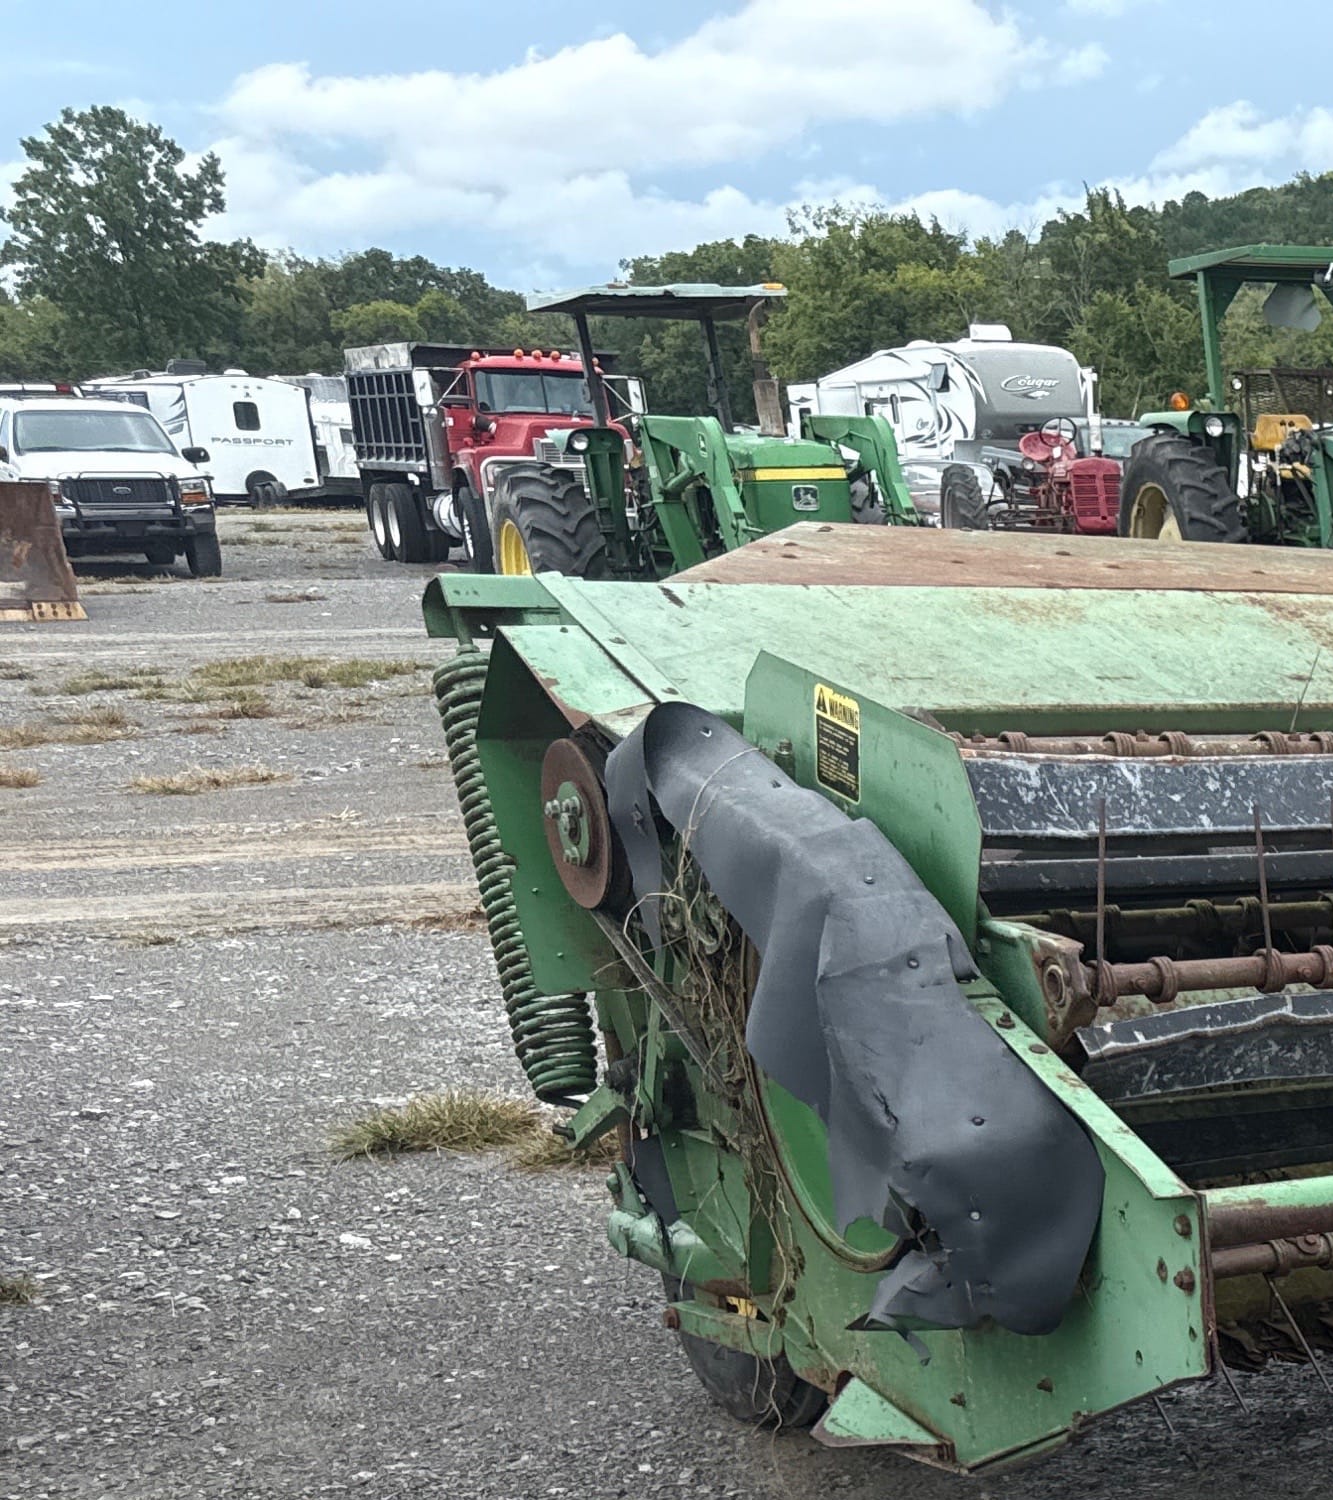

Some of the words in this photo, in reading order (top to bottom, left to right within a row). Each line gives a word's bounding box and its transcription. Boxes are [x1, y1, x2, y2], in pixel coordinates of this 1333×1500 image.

[1001, 375, 1059, 392] Cougar
[211, 437, 294, 446] PASSPORT
[828, 696, 859, 731] WARNING
